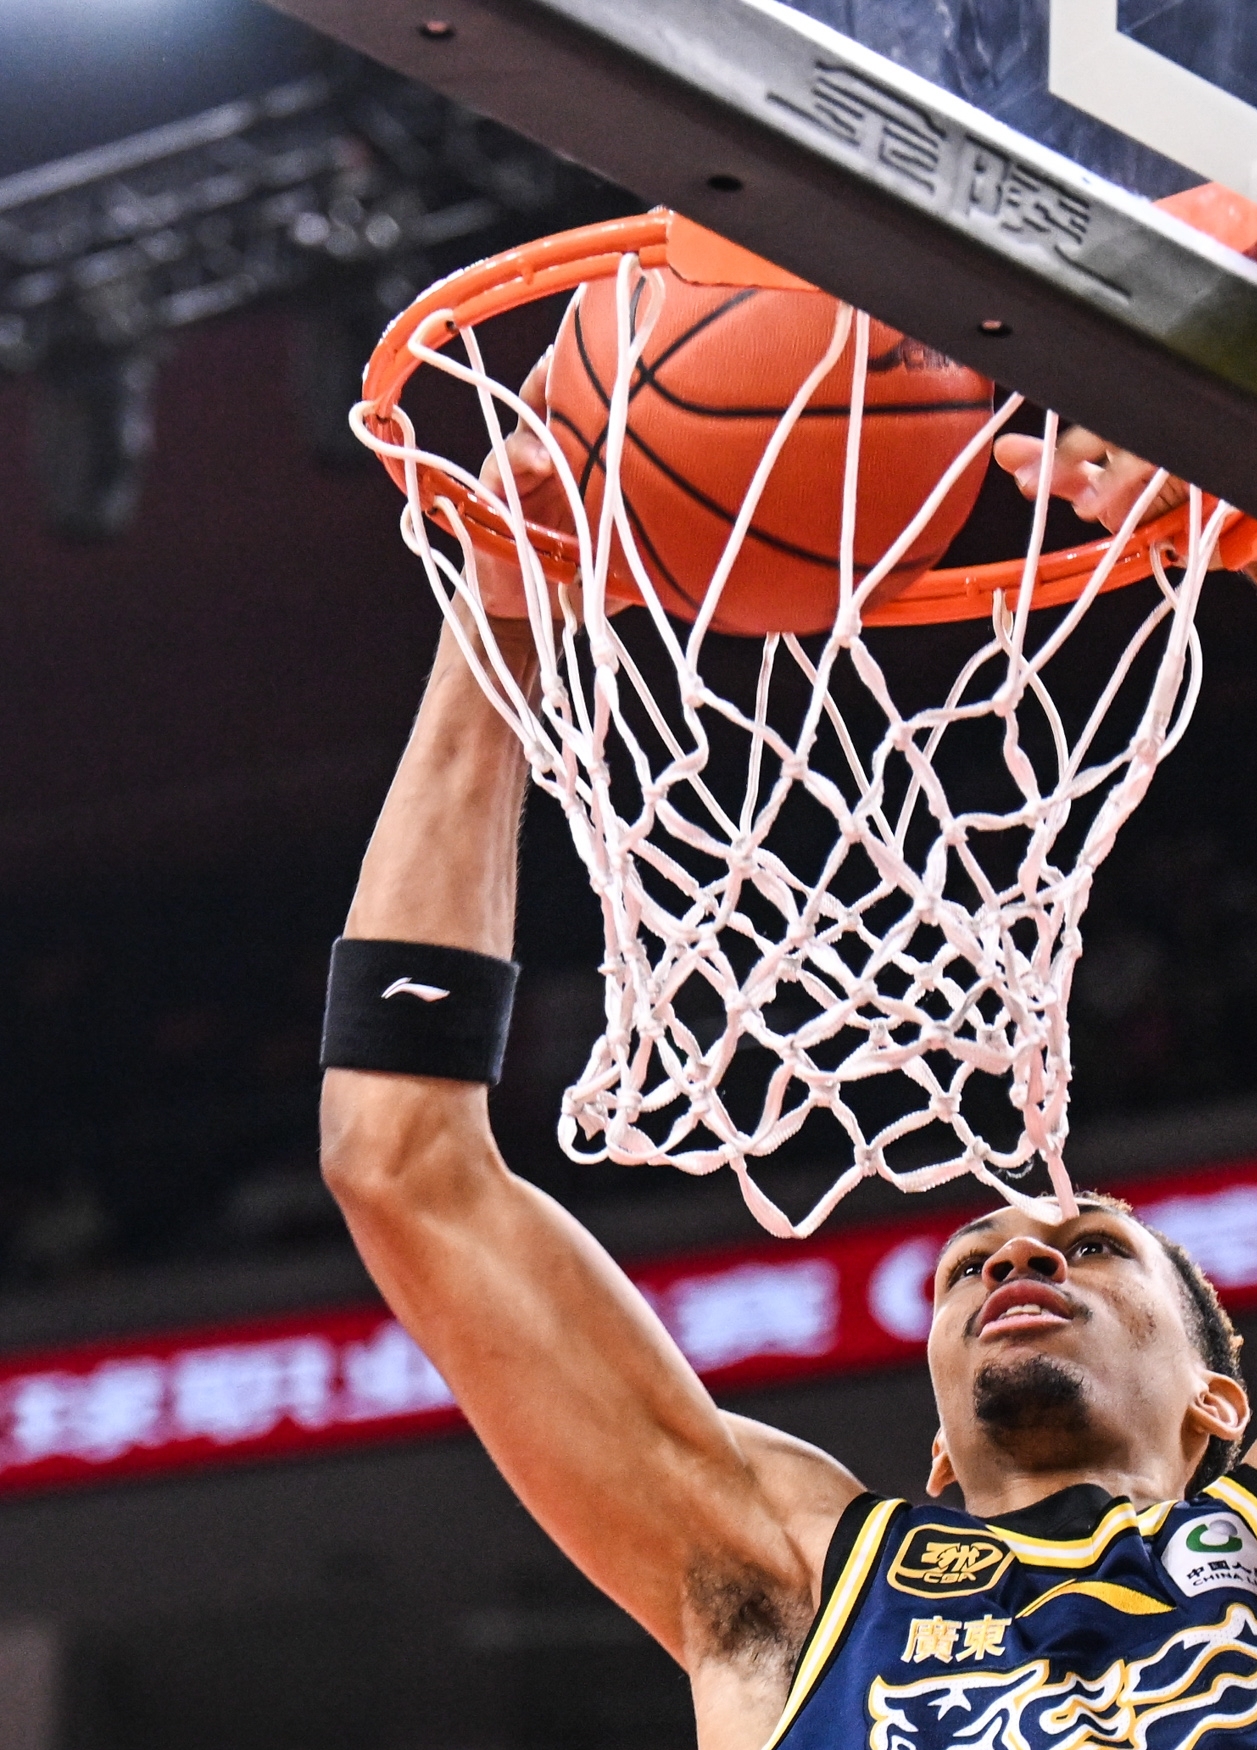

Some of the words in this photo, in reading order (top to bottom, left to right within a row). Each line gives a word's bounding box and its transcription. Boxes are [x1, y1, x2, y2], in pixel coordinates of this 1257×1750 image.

[923, 1571, 977, 1584] CBA
[1192, 1572, 1244, 1587] CHINA
[900, 1614, 1012, 1663] 廣東
